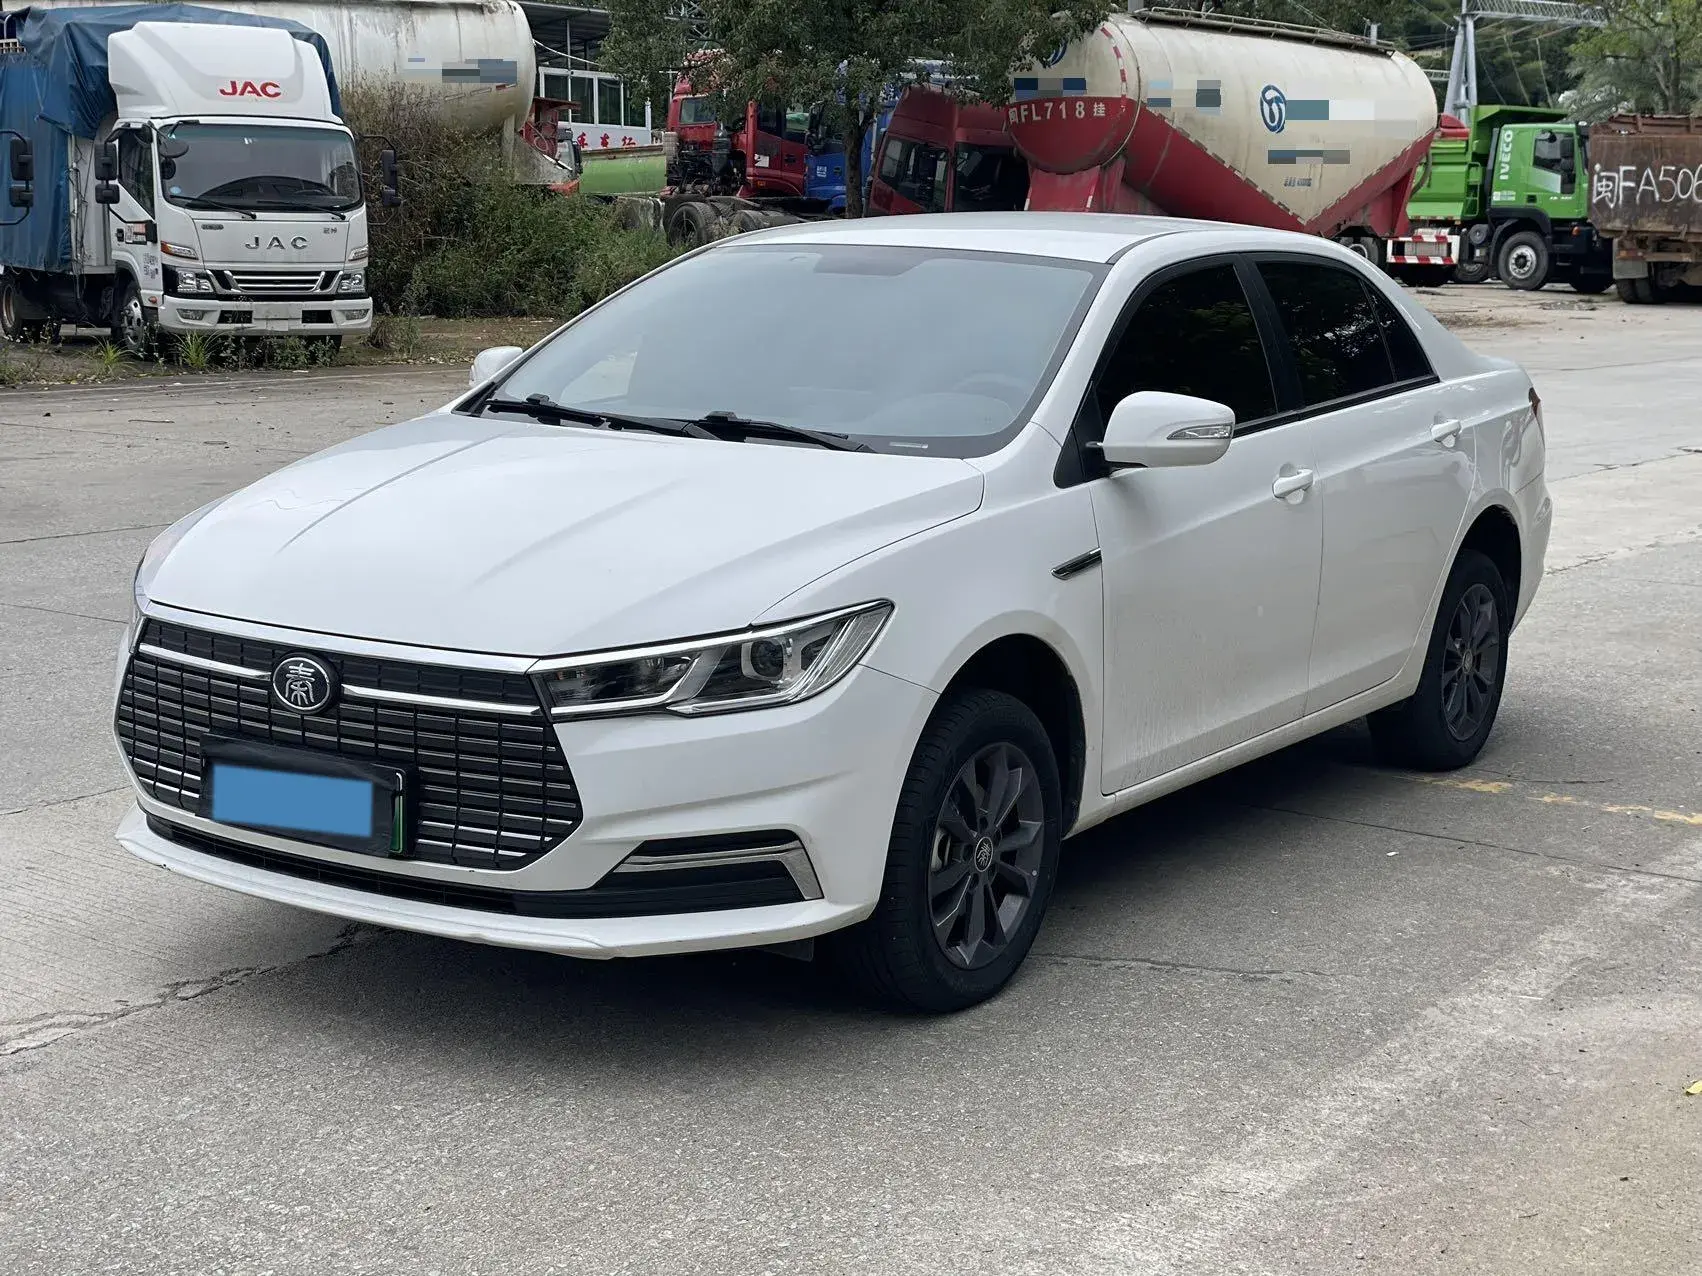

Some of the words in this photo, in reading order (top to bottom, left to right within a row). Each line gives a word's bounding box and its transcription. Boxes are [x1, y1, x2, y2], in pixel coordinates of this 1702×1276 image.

[219, 80, 281, 98] JAC
[1499, 129, 1513, 180] IVECO
[244, 236, 309, 250] JAC
